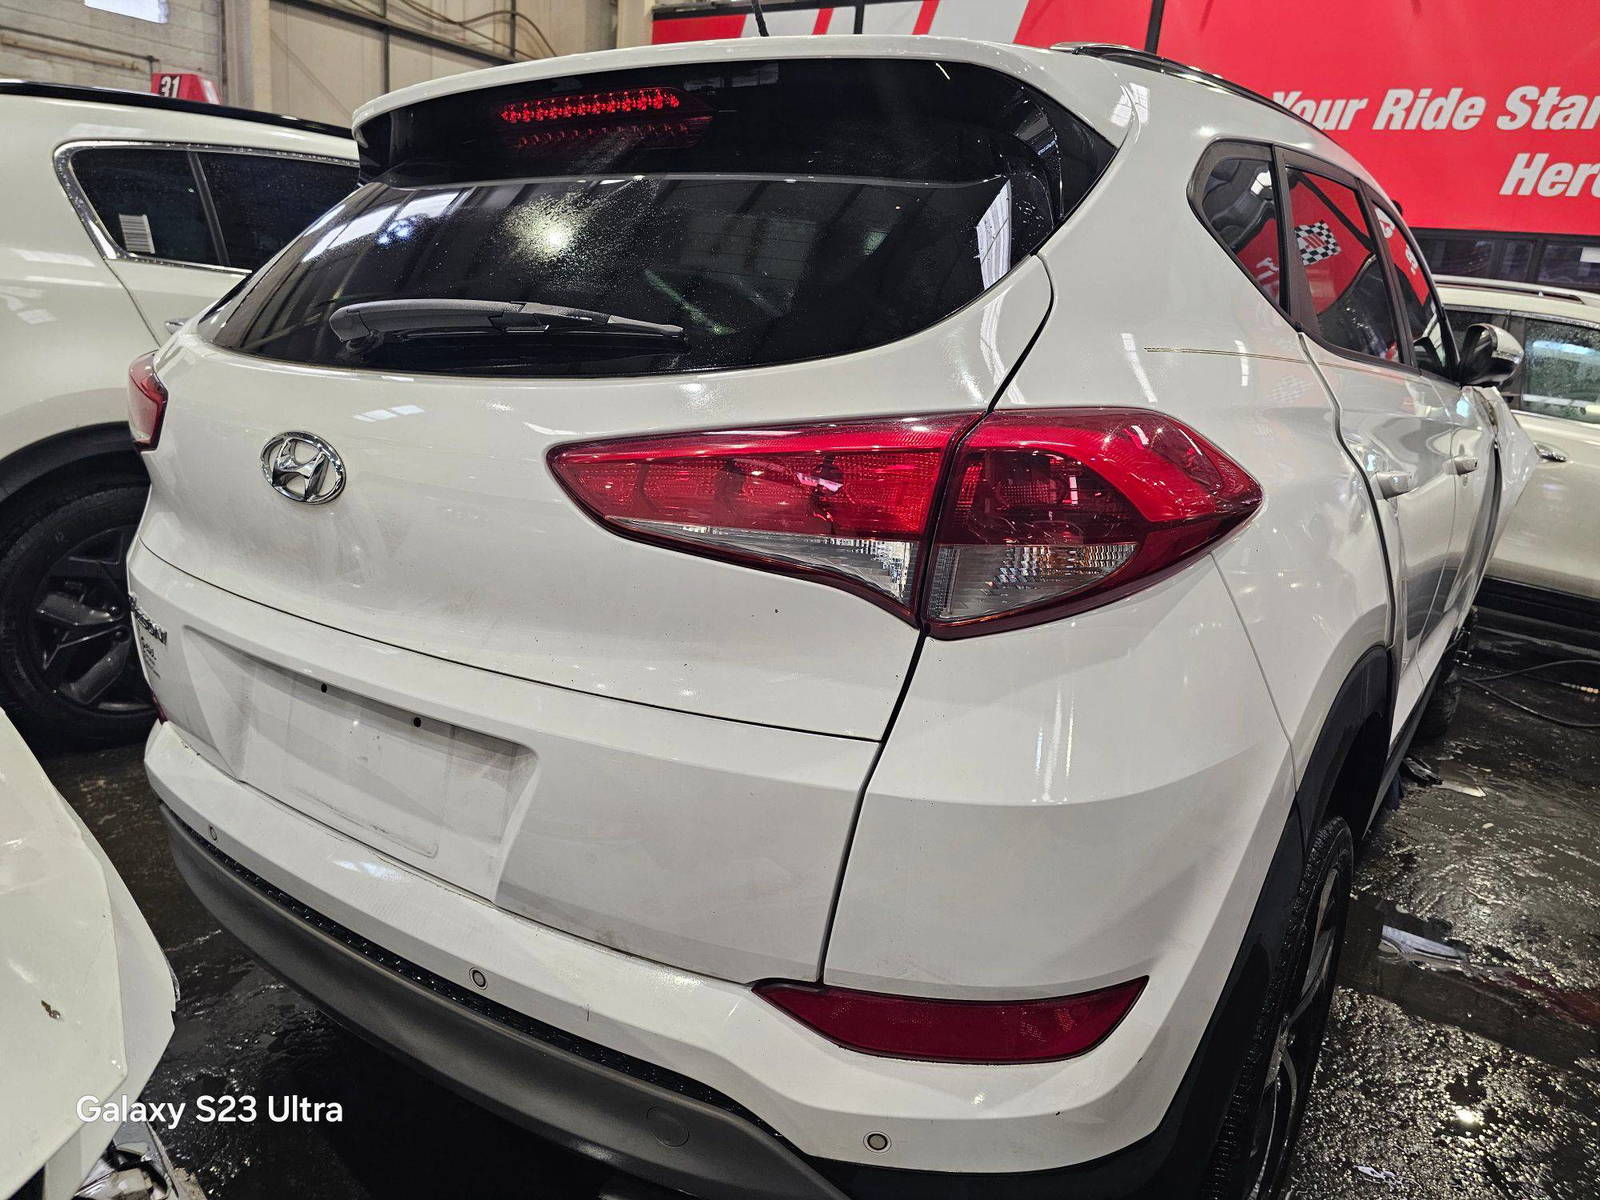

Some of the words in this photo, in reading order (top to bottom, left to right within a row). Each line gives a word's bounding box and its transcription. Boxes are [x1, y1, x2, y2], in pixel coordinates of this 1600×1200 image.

[161, 76, 180, 98] 31
[1372, 87, 1487, 131] Ride
[1499, 153, 1600, 198] Her
